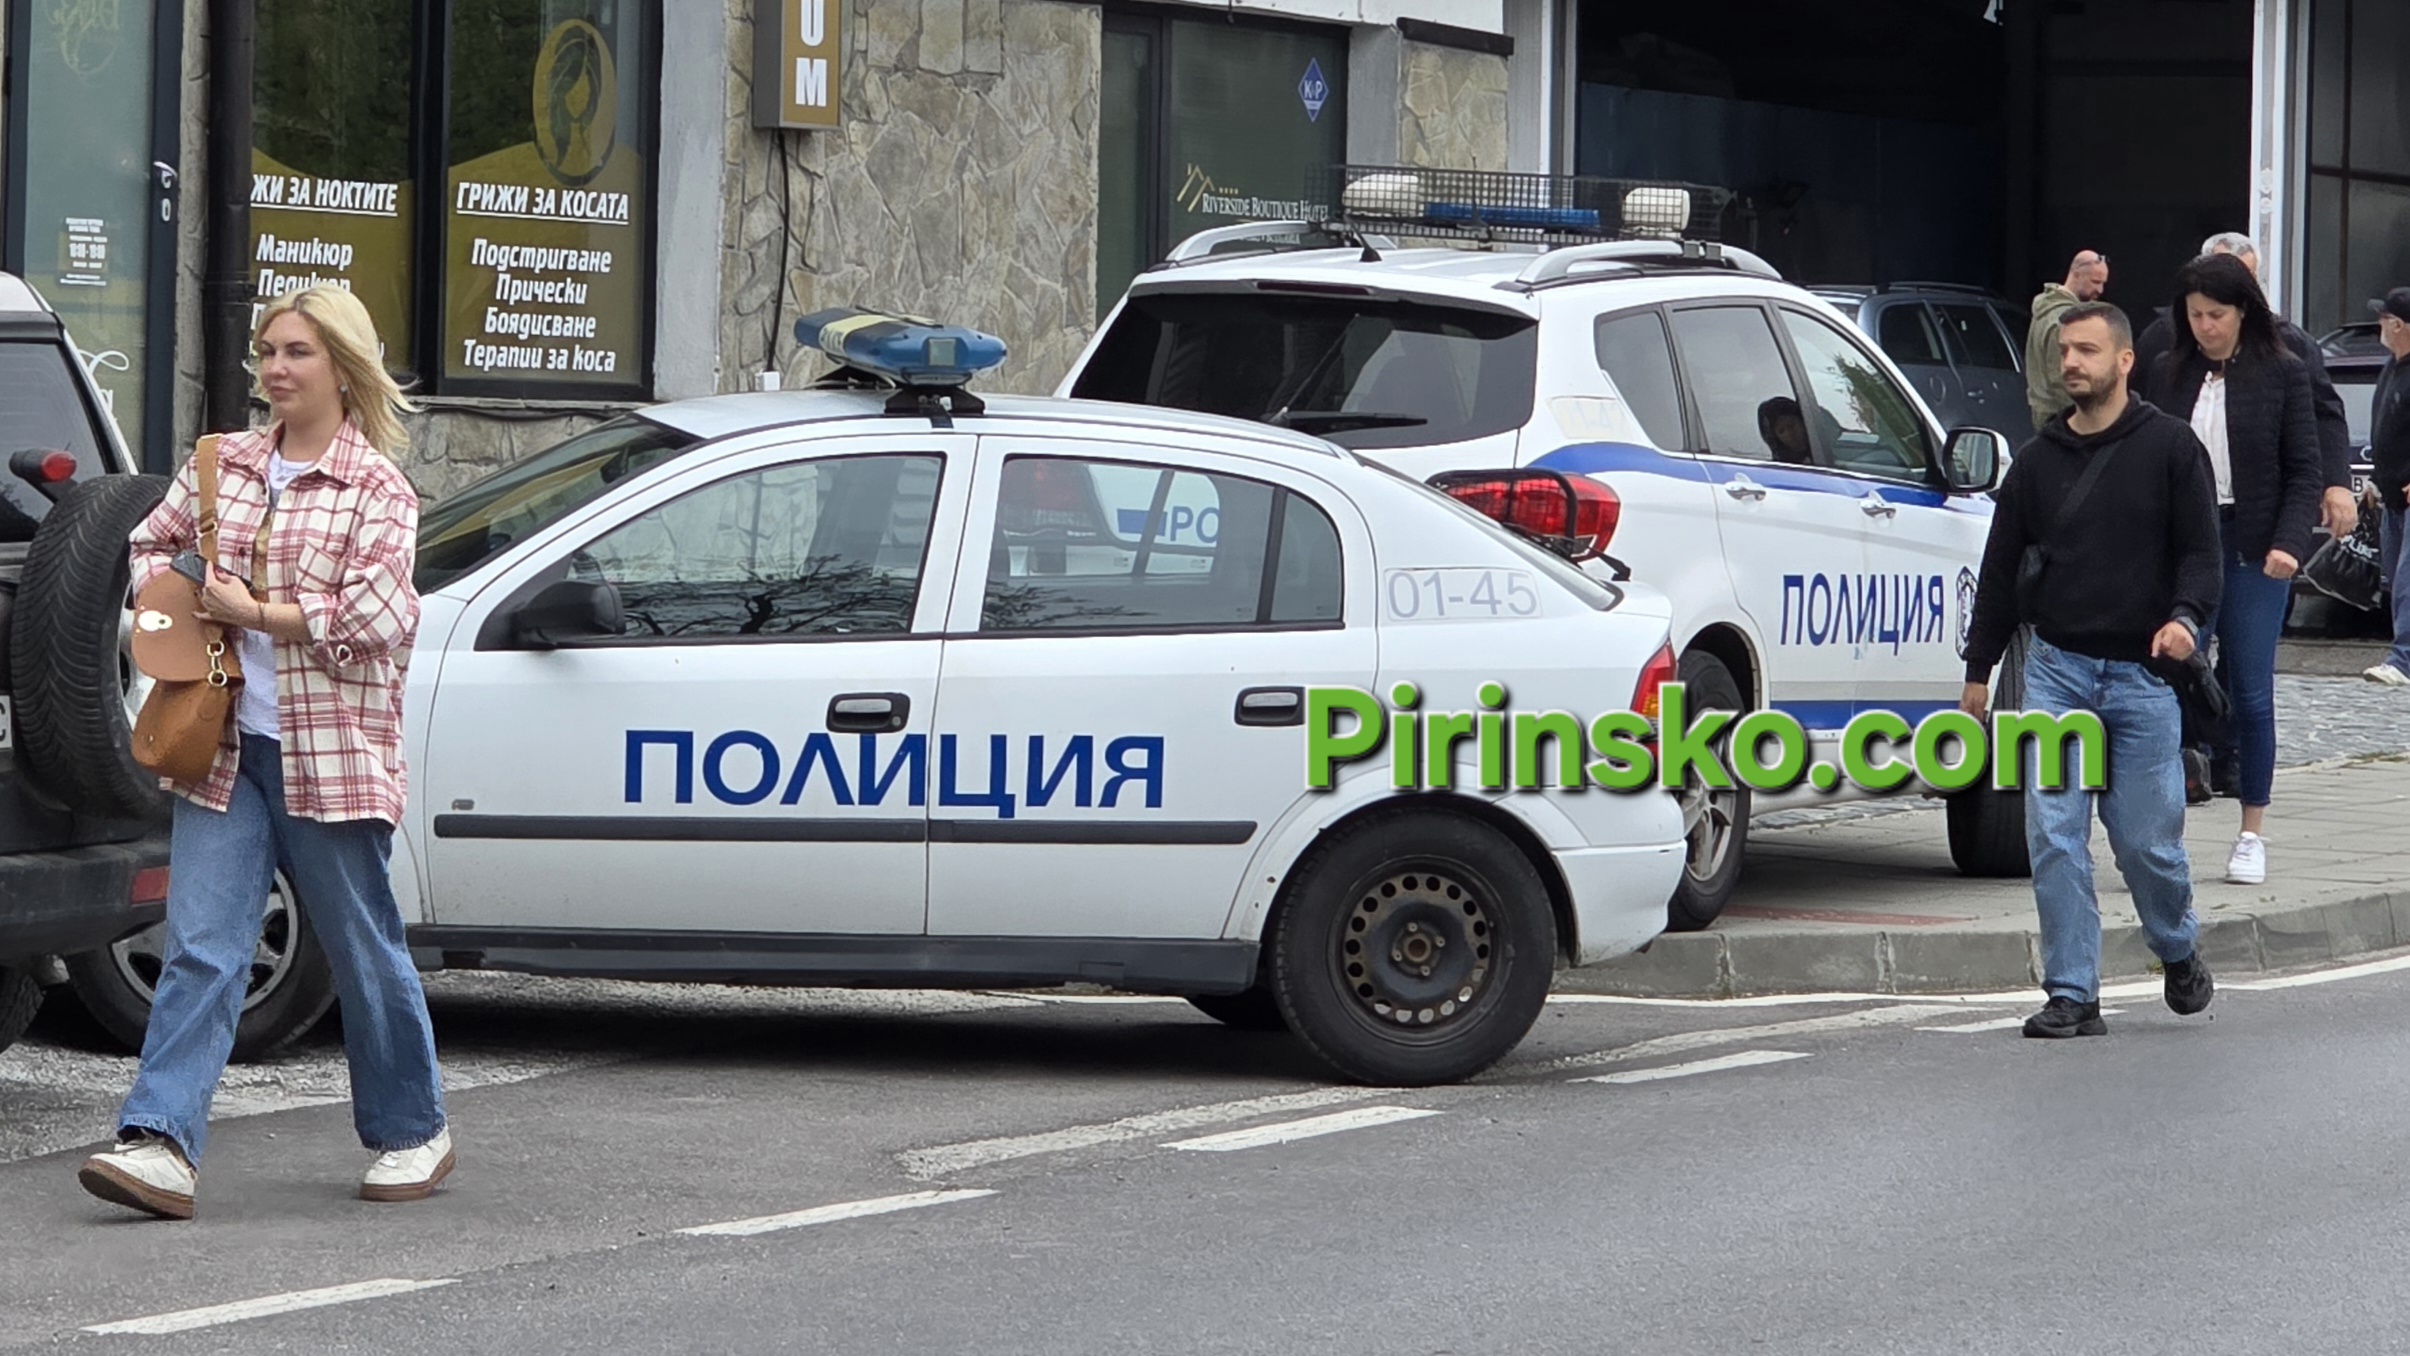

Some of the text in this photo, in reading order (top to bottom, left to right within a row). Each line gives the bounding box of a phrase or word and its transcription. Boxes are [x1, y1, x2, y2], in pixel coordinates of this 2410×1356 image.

[287, 176, 310, 205] ЗА
[314, 178, 398, 211] НОКТИТЕ
[456, 182, 629, 220] ГРИЖИ ЗА КОСАТА
[256, 234, 353, 271] Маникюр
[471, 238, 612, 274] Подстригване
[496, 273, 587, 305] Прически
[485, 306, 596, 340] Боядисване
[464, 339, 616, 373] Терапии за коса
[1388, 571, 1537, 618] 01-45
[1781, 573, 1944, 656] ПОЛИЦИЯ
[625, 730, 1164, 819] ПОЛИЦИЯ
